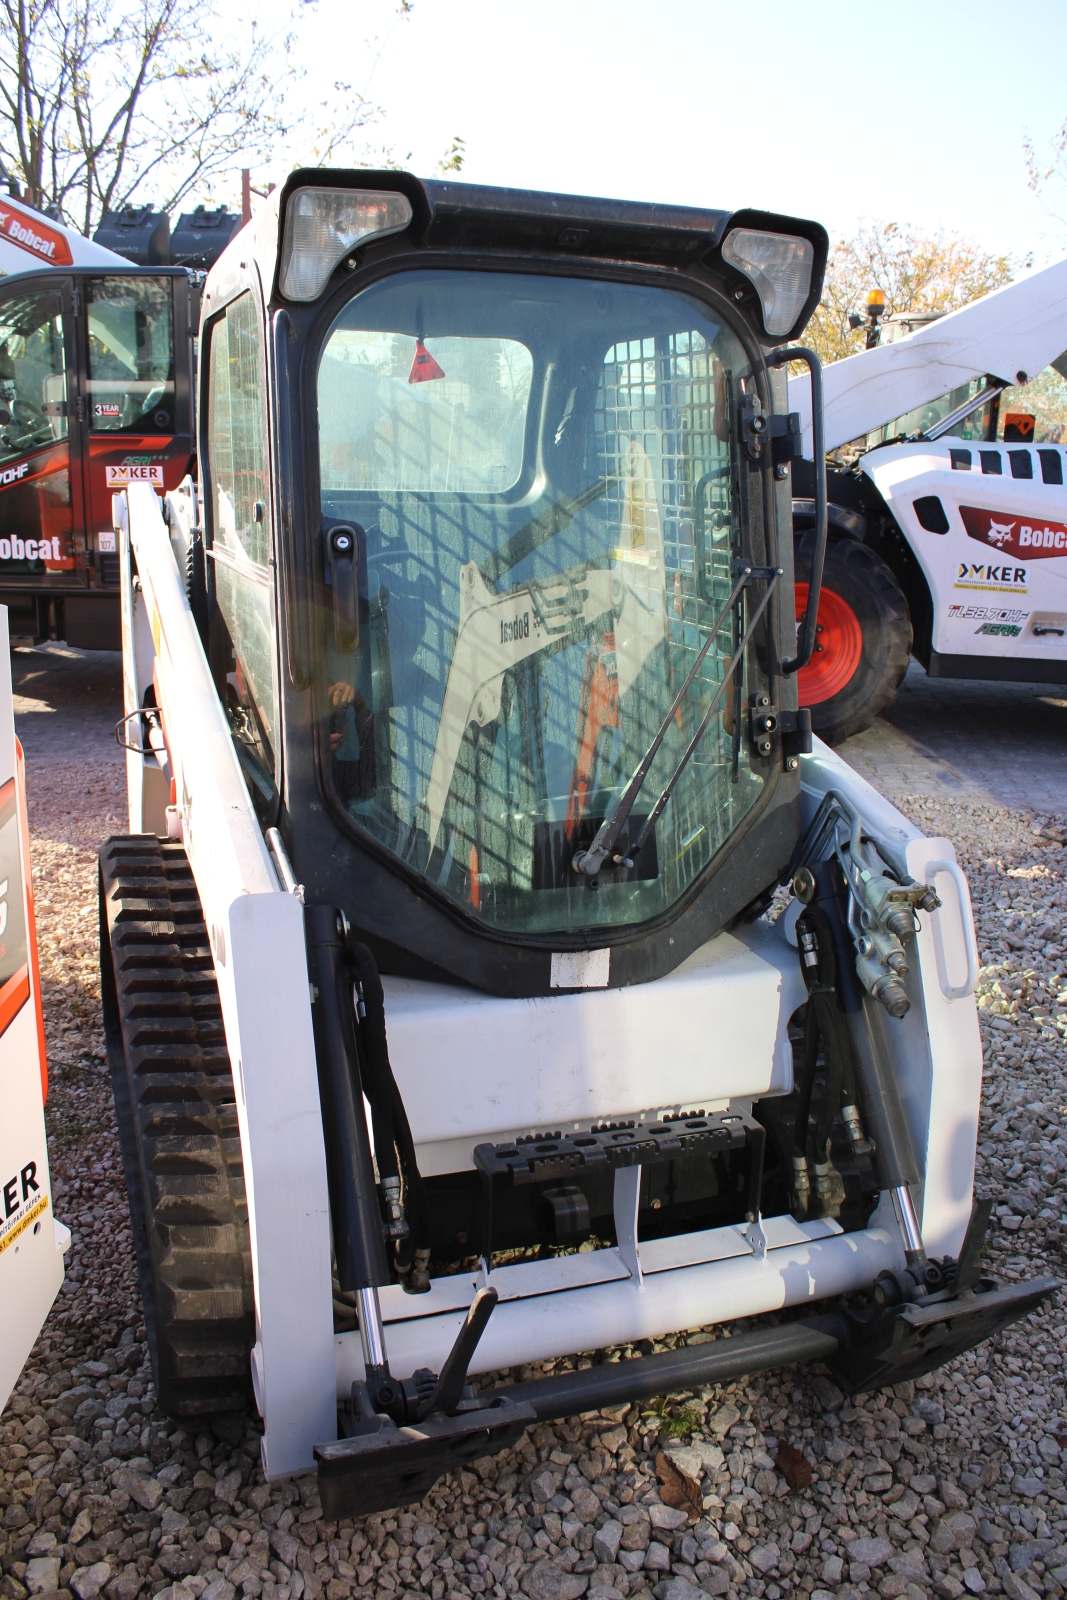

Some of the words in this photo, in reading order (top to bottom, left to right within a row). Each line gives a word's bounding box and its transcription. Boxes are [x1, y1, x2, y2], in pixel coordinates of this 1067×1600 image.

[8, 219, 56, 257] Bobcat
[95, 404, 102, 416] 3
[121, 456, 152, 466] AGRI
[0, 534, 61, 561] obcat
[1019, 525, 1067, 549] Bobca
[948, 605, 1030, 622] TL38.70HF
[974, 623, 1014, 636] AGRI
[0, 1160, 40, 1226] ER
[0, 1209, 25, 1239] PÍTŐIPARI
[25, 1193, 42, 1212] GÉPEK
[8, 1201, 47, 1242] www.dmker.hu
